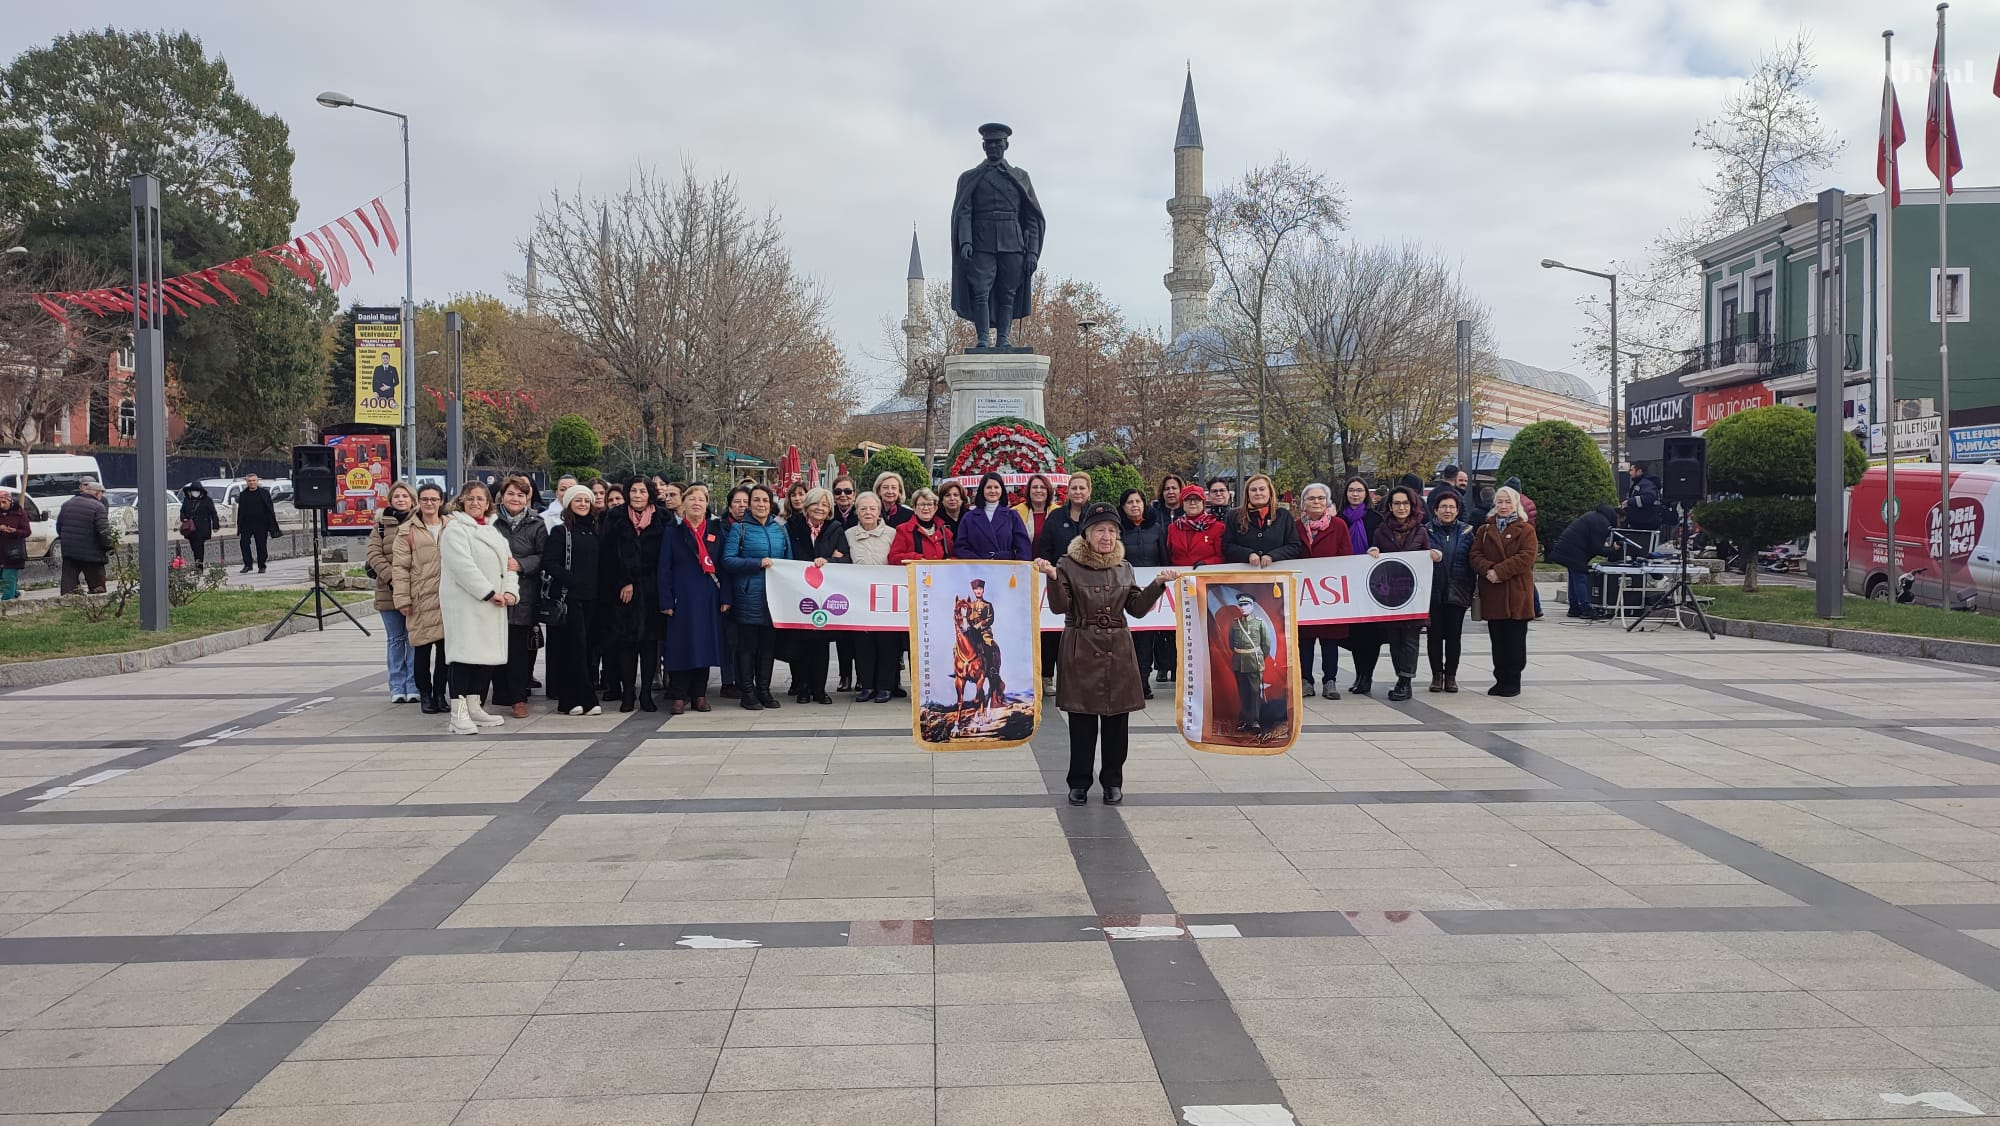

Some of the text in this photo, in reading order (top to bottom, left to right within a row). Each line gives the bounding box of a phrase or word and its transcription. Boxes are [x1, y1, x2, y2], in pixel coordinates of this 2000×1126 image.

[1630, 398, 1683, 426] KIVILCIM
[1707, 402, 1724, 421] NUR
[1904, 419, 1937, 435] İLETİŞİM
[1916, 438, 1930, 448] SATI
[1930, 522, 1975, 543] İKAM
[1299, 575, 1351, 607] ASI
